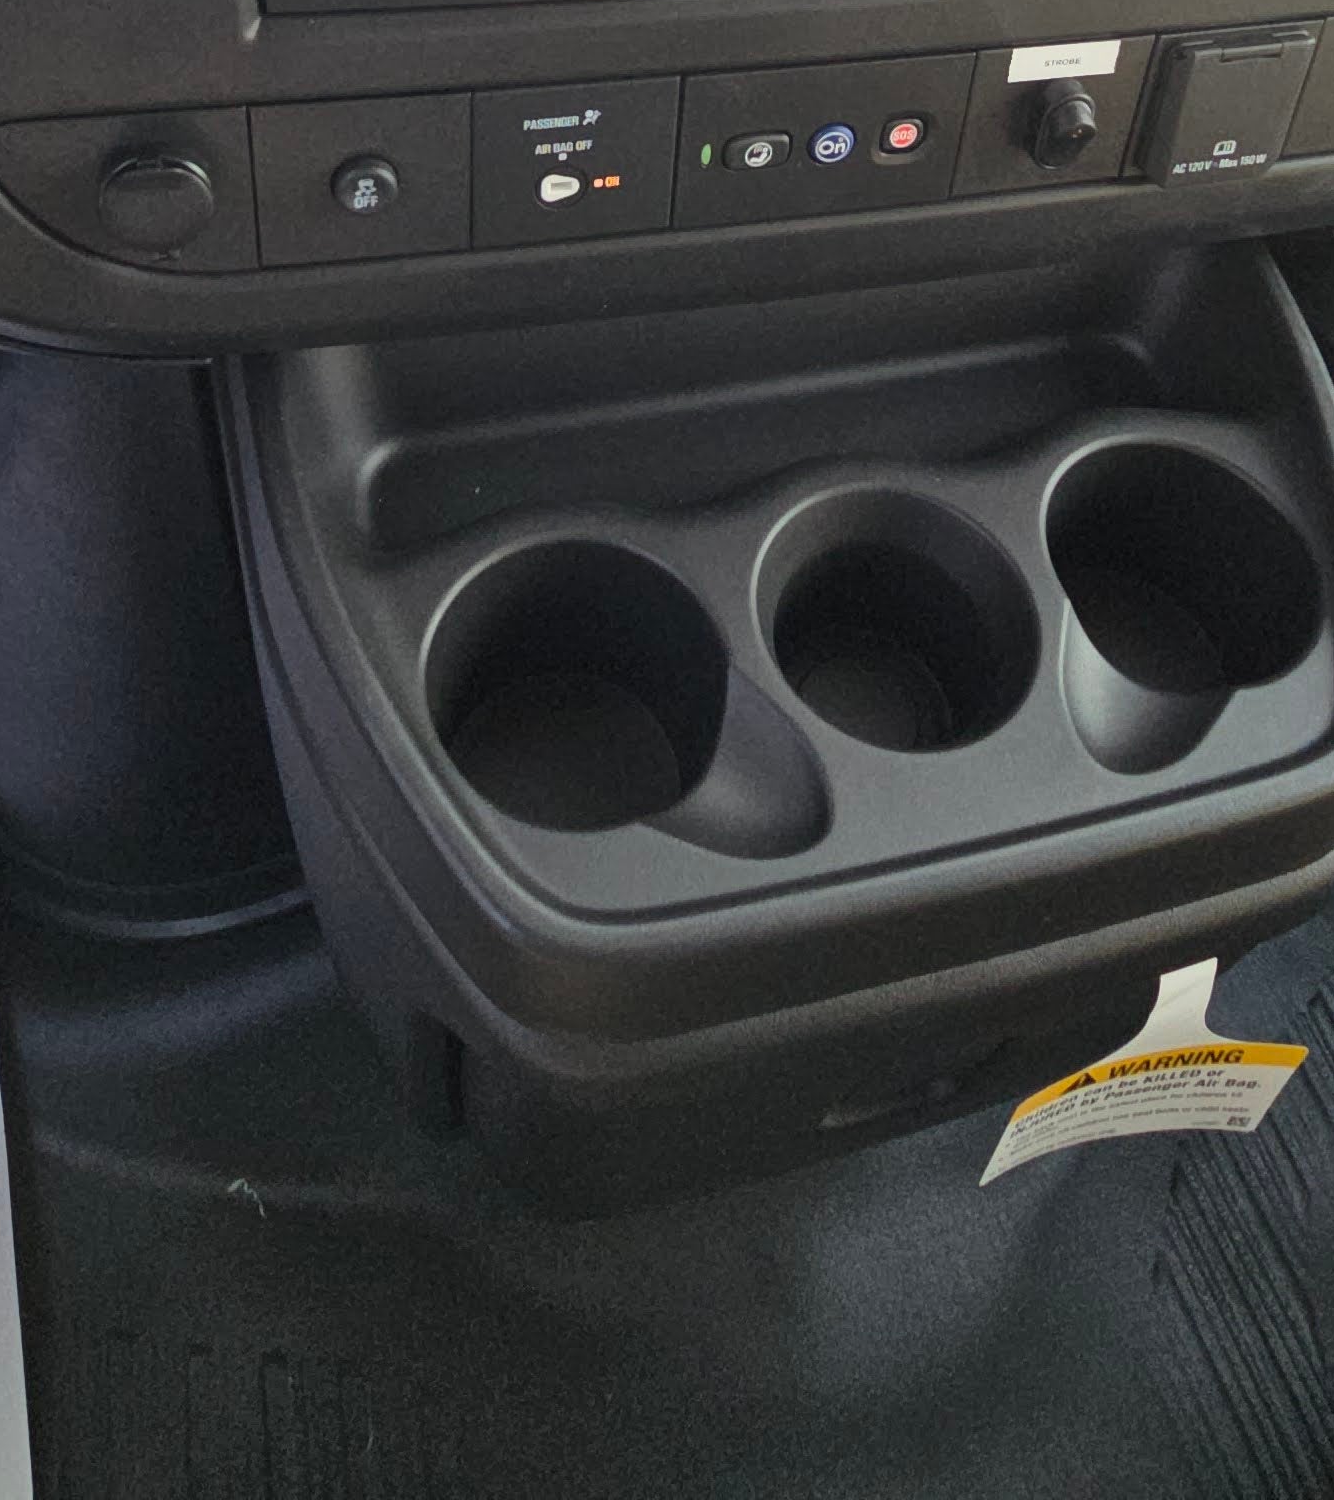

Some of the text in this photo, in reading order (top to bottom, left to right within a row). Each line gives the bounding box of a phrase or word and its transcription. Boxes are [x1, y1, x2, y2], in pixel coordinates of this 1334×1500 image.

[523, 115, 580, 131] PASSENGER
[893, 129, 915, 142] SOS
[535, 139, 593, 155] AIR BAG OFF
[818, 139, 847, 155] On
[1172, 162, 1188, 174] AC
[1188, 161, 1204, 172] 120
[605, 176, 620, 188] ON
[353, 195, 379, 209] OFF
[1108, 1049, 1246, 1080] WARNING
[1143, 1069, 1202, 1085] KILLED
[1104, 1081, 1190, 1101] Passenger
[1195, 1079, 1219, 1088] Air
